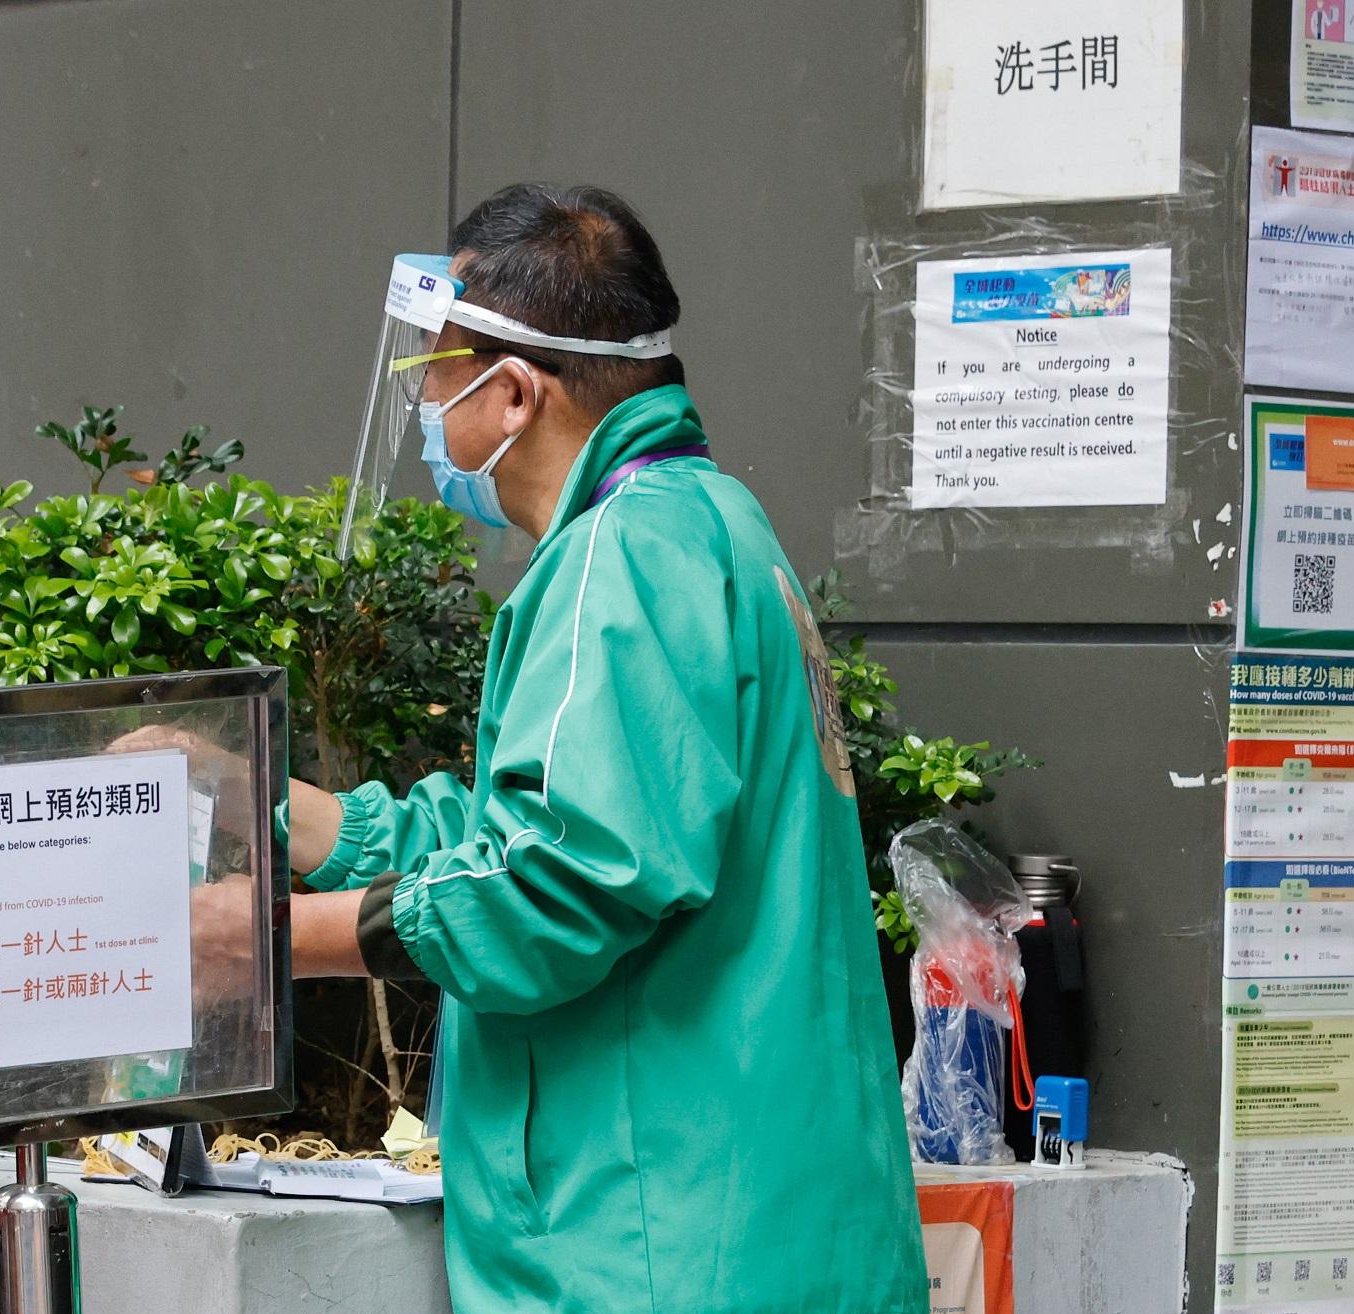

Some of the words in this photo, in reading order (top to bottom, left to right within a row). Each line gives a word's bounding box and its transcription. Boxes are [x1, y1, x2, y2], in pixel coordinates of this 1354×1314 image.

[995, 35, 1118, 95] 洗手間
[1016, 328, 1057, 343] Notice
[937, 361, 946, 374] If
[963, 363, 985, 378] you
[1002, 361, 1021, 373] are
[1038, 355, 1110, 374] undergoing
[1128, 357, 1135, 368] a
[1014, 385, 1061, 402] testing,
[1070, 383, 1108, 400] please
[1118, 382, 1134, 396] do
[936, 418, 957, 431] not
[960, 417, 991, 430] enter
[996, 414, 1017, 429] this
[1022, 412, 1090, 428] vaccination
[1095, 412, 1133, 426] centre
[935, 445, 962, 459] until
[965, 448, 972, 459] a
[976, 443, 1027, 462] negative
[1031, 442, 1065, 457] result
[1069, 442, 1078, 456] is
[1082, 440, 1137, 455] received.
[935, 474, 970, 487] Thank
[973, 475, 999, 490] you.
[1229, 689, 1249, 700] How
[1250, 691, 1271, 702] many
[1272, 690, 1293, 700] doses
[1294, 690, 1301, 700] of
[1302, 690, 1337, 701] COVID-19
[8, 838, 36, 851] below
[38, 835, 92, 849] categories:
[5, 901, 24, 911] from
[26, 897, 66, 909] COVID-19
[68, 895, 104, 904] infection
[108, 938, 127, 948] dose
[138, 935, 159, 945] clinic
